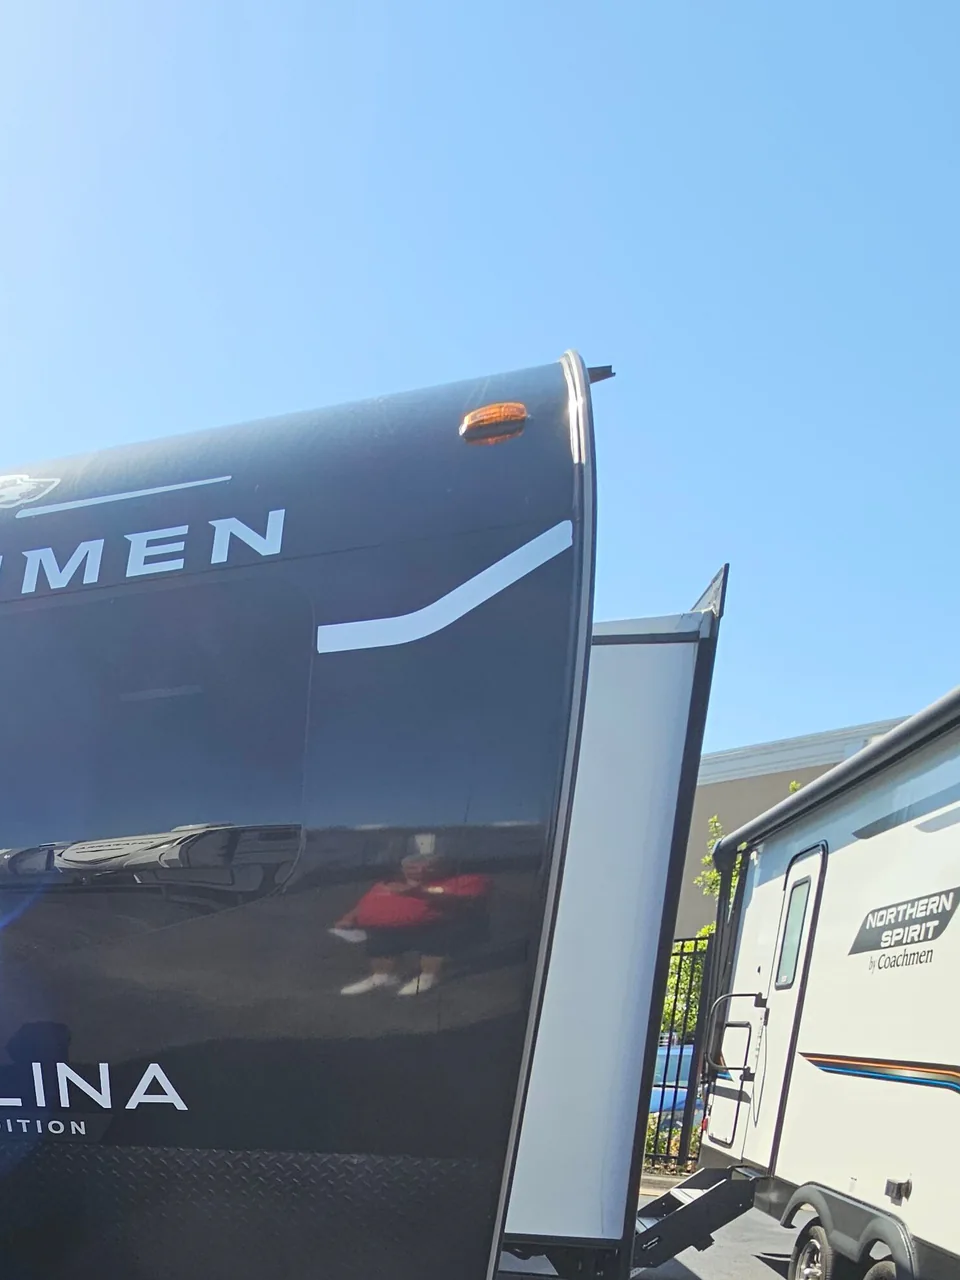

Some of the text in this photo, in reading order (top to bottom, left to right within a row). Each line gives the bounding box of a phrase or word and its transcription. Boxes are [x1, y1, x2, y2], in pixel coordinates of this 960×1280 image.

[865, 891, 954, 930] NORTHERN
[880, 920, 939, 948] SPIRIT
[868, 948, 934, 975] by Coachmen
